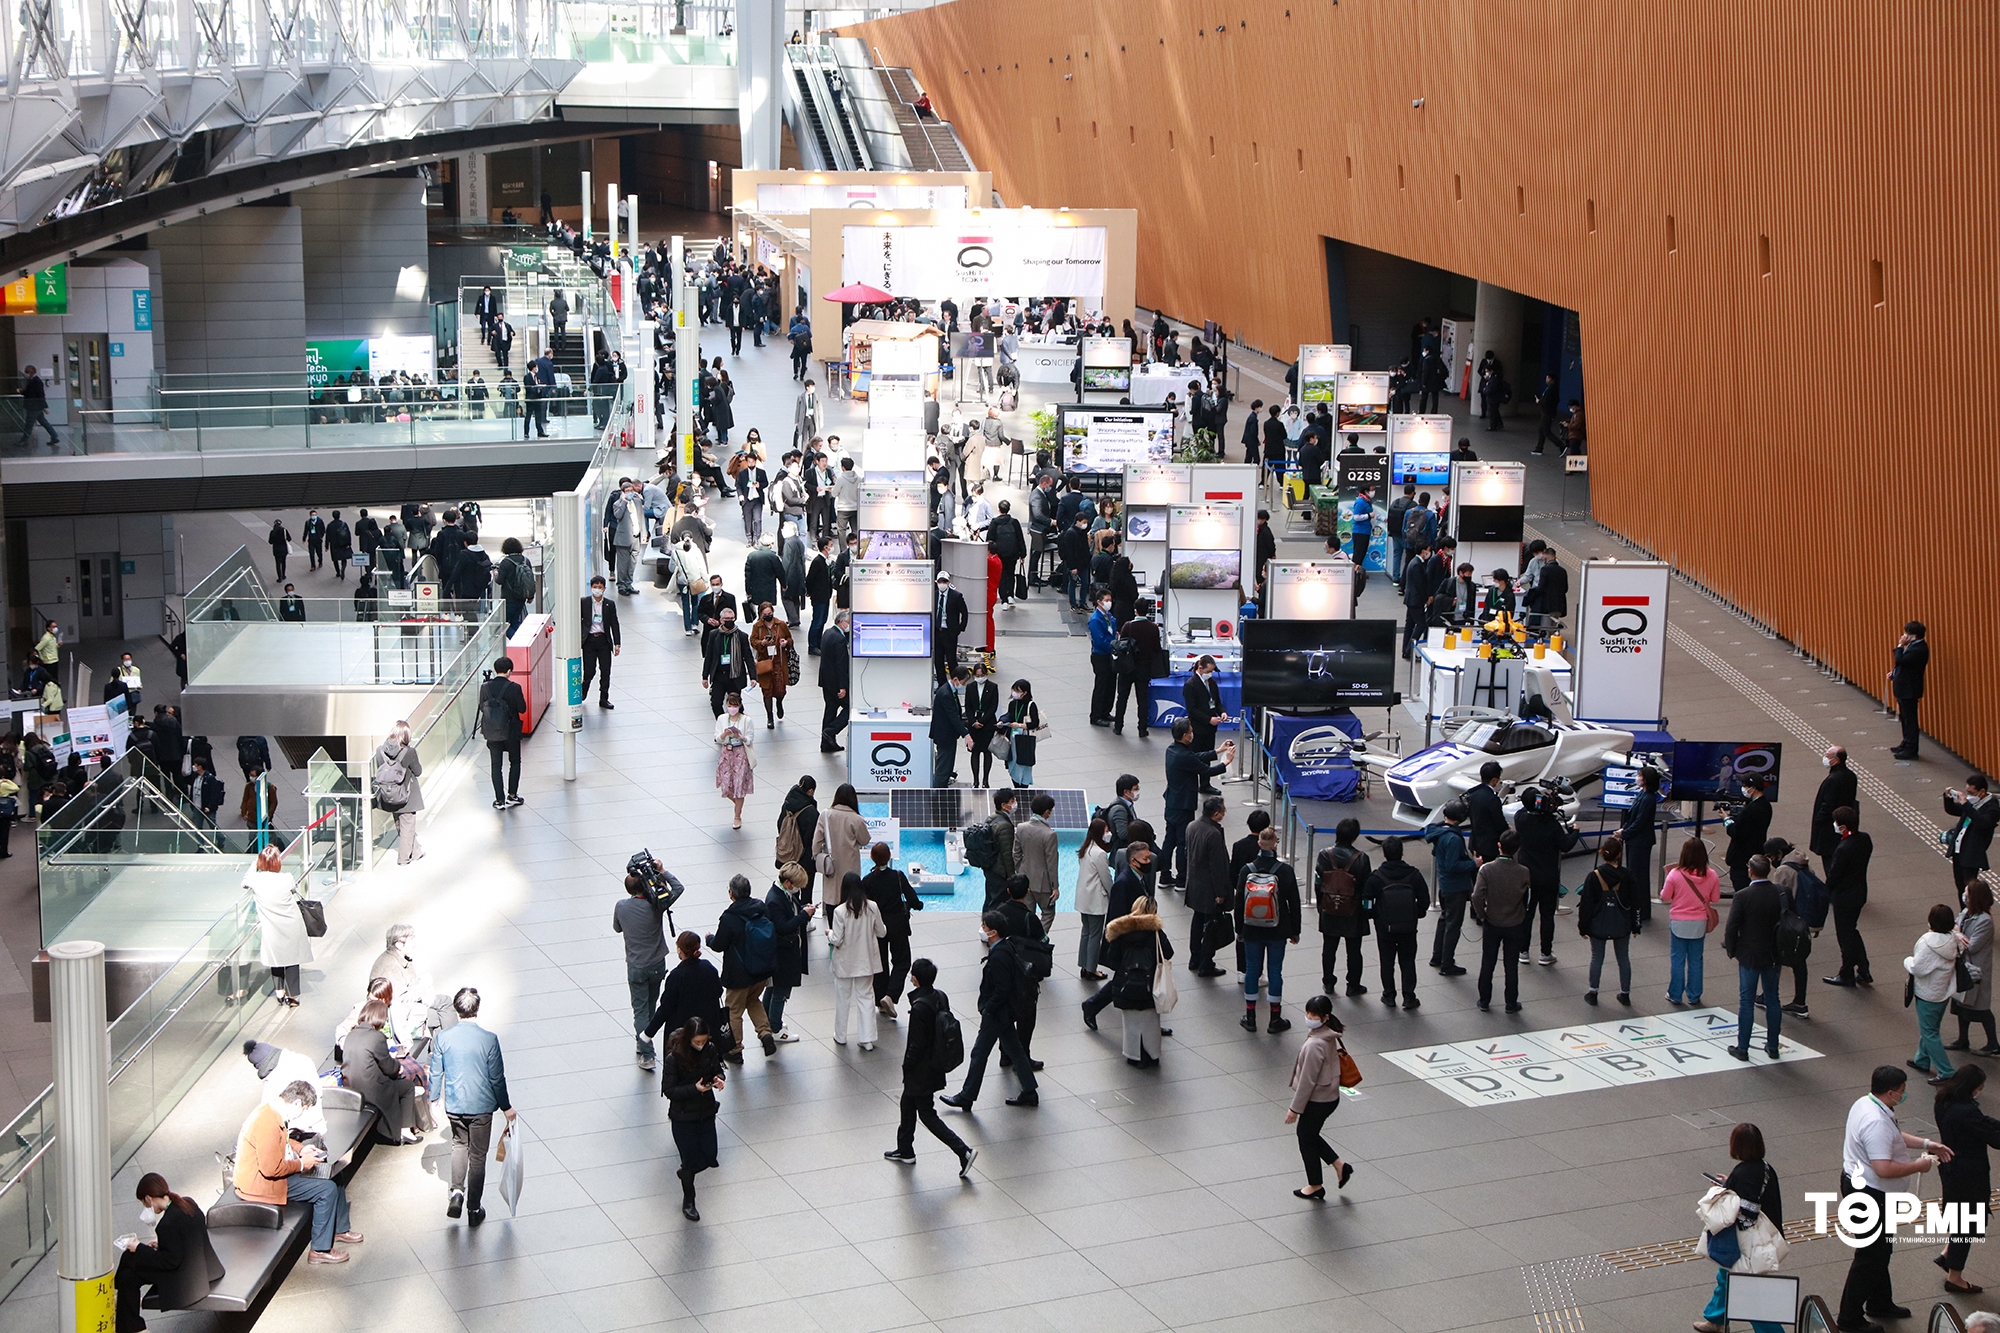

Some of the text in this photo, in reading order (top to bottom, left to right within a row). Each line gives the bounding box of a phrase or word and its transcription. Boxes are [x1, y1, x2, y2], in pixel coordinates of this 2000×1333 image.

[1023, 258, 1051, 266] Shaping
[15, 285, 26, 296] B
[46, 285, 57, 295] A
[138, 298, 147, 309] E
[306, 373, 328, 384] okyo
[1347, 471, 1381, 481] QZSS
[1599, 637, 1648, 645] SusHi Tech
[1301, 769, 1330, 777] SKYDRIVE
[1641, 1038, 1673, 1046] hall
[1582, 1045, 1614, 1055] hall
[1666, 1047, 1712, 1064] A
[1500, 1056, 1533, 1066] hall
[1597, 1054, 1648, 1071] B
[1440, 1065, 1473, 1075] hall
[1519, 1066, 1564, 1083] C
[1454, 1075, 1502, 1093] D
[1483, 1090, 1517, 1100] 1,5,7
